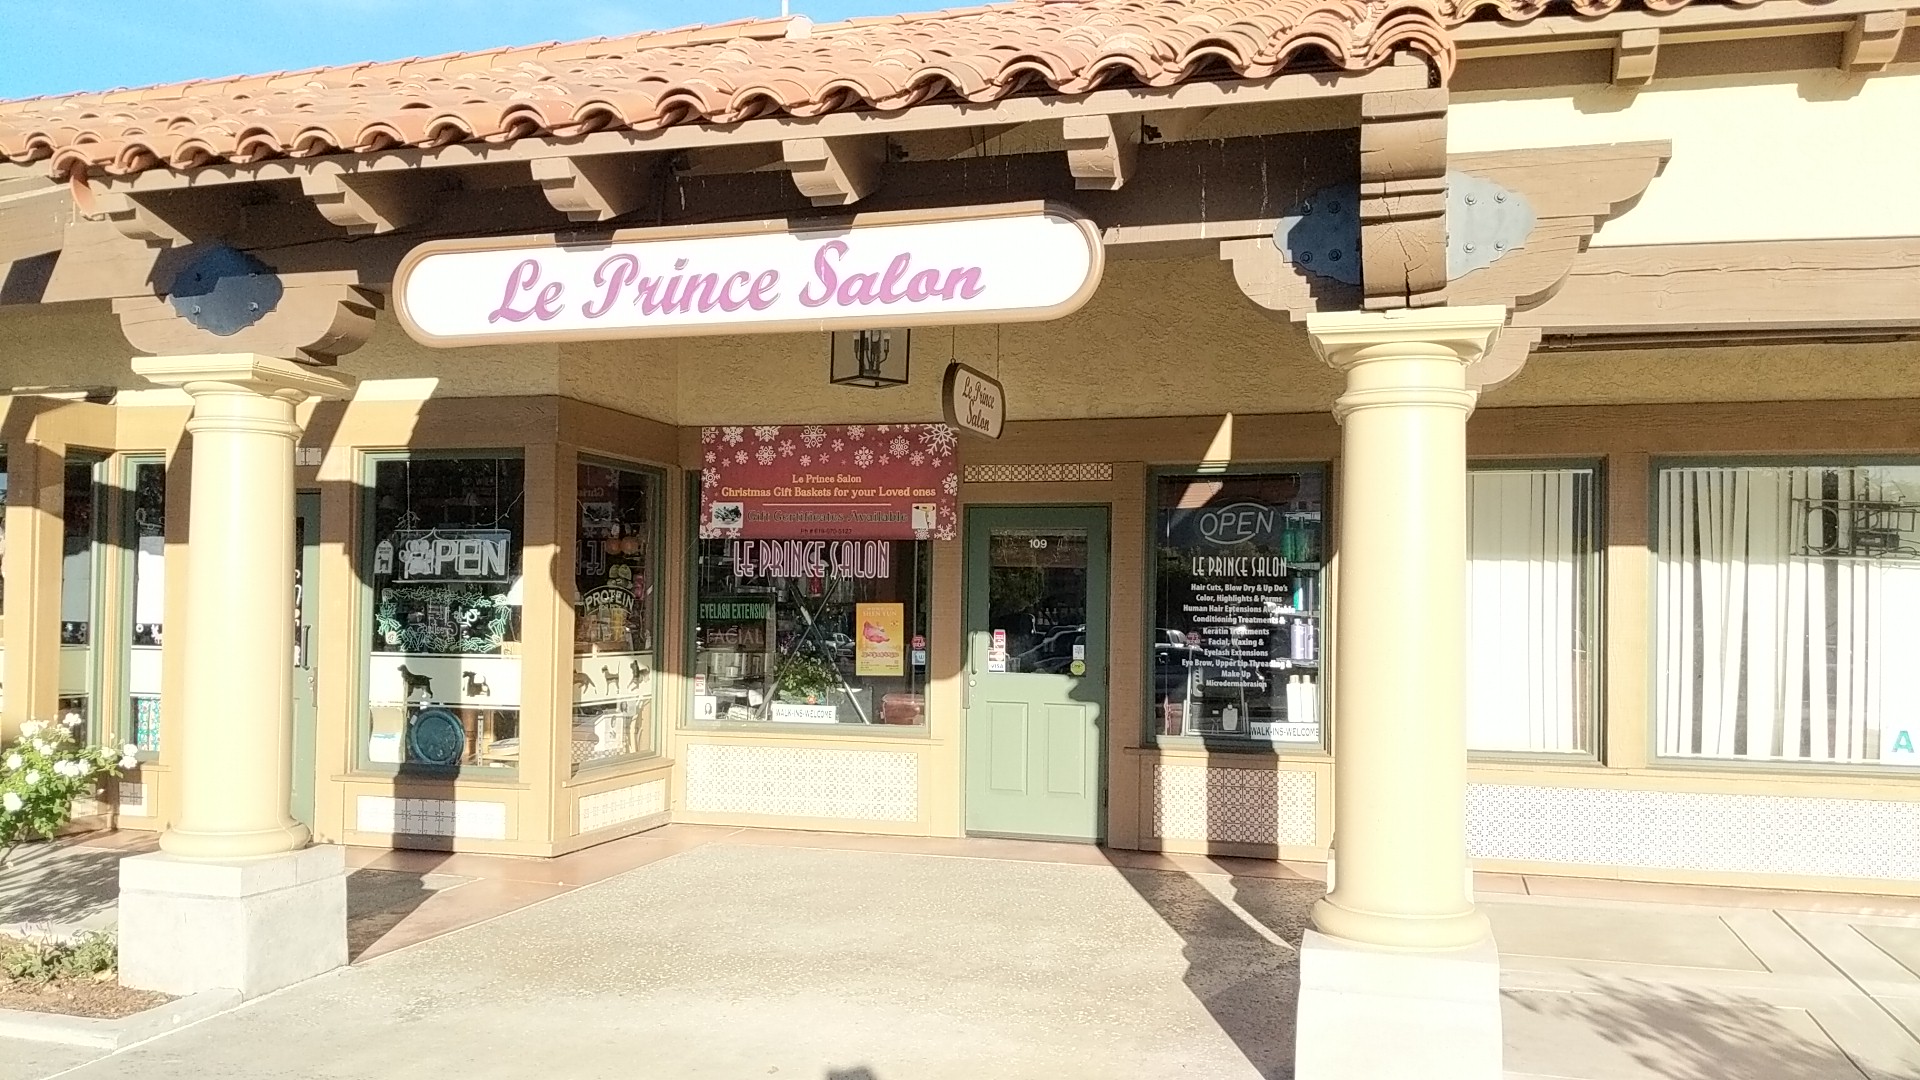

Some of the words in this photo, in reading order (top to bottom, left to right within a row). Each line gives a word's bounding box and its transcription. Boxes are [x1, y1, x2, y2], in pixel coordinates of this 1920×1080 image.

[488, 259, 565, 323] Le
[581, 253, 781, 319] Prince
[799, 239, 986, 307] Salon
[962, 376, 972, 399] Le
[973, 381, 995, 409] Prince
[967, 400, 989, 431] Salon
[792, 474, 804, 484] Le
[806, 474, 835, 484] Prince
[837, 474, 861, 484] Salon
[721, 487, 771, 497] Christmas
[773, 487, 793, 497] Gift
[795, 487, 831, 497] Baskets
[834, 487, 847, 497] for
[849, 488, 876, 499] your
[878, 487, 910, 497] Loved
[912, 489, 936, 497] ones
[747, 510, 771, 521] Gift
[773, 510, 843, 521] Certificates
[850, 510, 909, 521] Available
[1200, 511, 1274, 535] OPEN
[1029, 539, 1048, 549] 109
[733, 541, 755, 577] LE
[759, 540, 825, 578] PRINCE
[829, 540, 890, 579] SALON
[1192, 557, 1204, 577] LE
[1208, 557, 1248, 577] PRINCE
[1251, 557, 1287, 577] SALON
[1191, 584, 1206, 592] Hair
[1206, 584, 1224, 593] Cuts,
[1225, 584, 1242, 592] Blow
[1243, 584, 1256, 593] Dry
[1257, 584, 1262, 592] &
[1263, 585, 1273, 593] Up
[1196, 594, 1216, 603] Color,
[1216, 594, 1252, 603] Highlights
[700, 603, 731, 619] EYELASH
[732, 603, 770, 619] EXTENSION
[1183, 604, 1208, 612] Human
[1224, 605, 1262, 613] Extensions
[1192, 615, 1237, 624] Conditioning
[1238, 616, 1279, 624] Treatments
[1203, 627, 1229, 635] Keratin
[1230, 627, 1270, 635] Treatments
[1208, 639, 1230, 647] Facial,
[1231, 639, 1257, 648] Waxing
[1204, 649, 1230, 657] Eyelash
[1231, 649, 1269, 657] Extensions
[1182, 660, 1194, 668] Eye
[1194, 660, 1215, 668] Brow,
[1215, 660, 1236, 668] Upper
[1237, 660, 1249, 668] Lip
[1249, 660, 1285, 669] Threading
[1221, 670, 1240, 678] Make
[1241, 670, 1251, 679] Up
[1206, 679, 1267, 688] Microdermabrasion
[1251, 726, 1319, 737] WALK-INS-WELCOME
[1891, 731, 1914, 753] A
